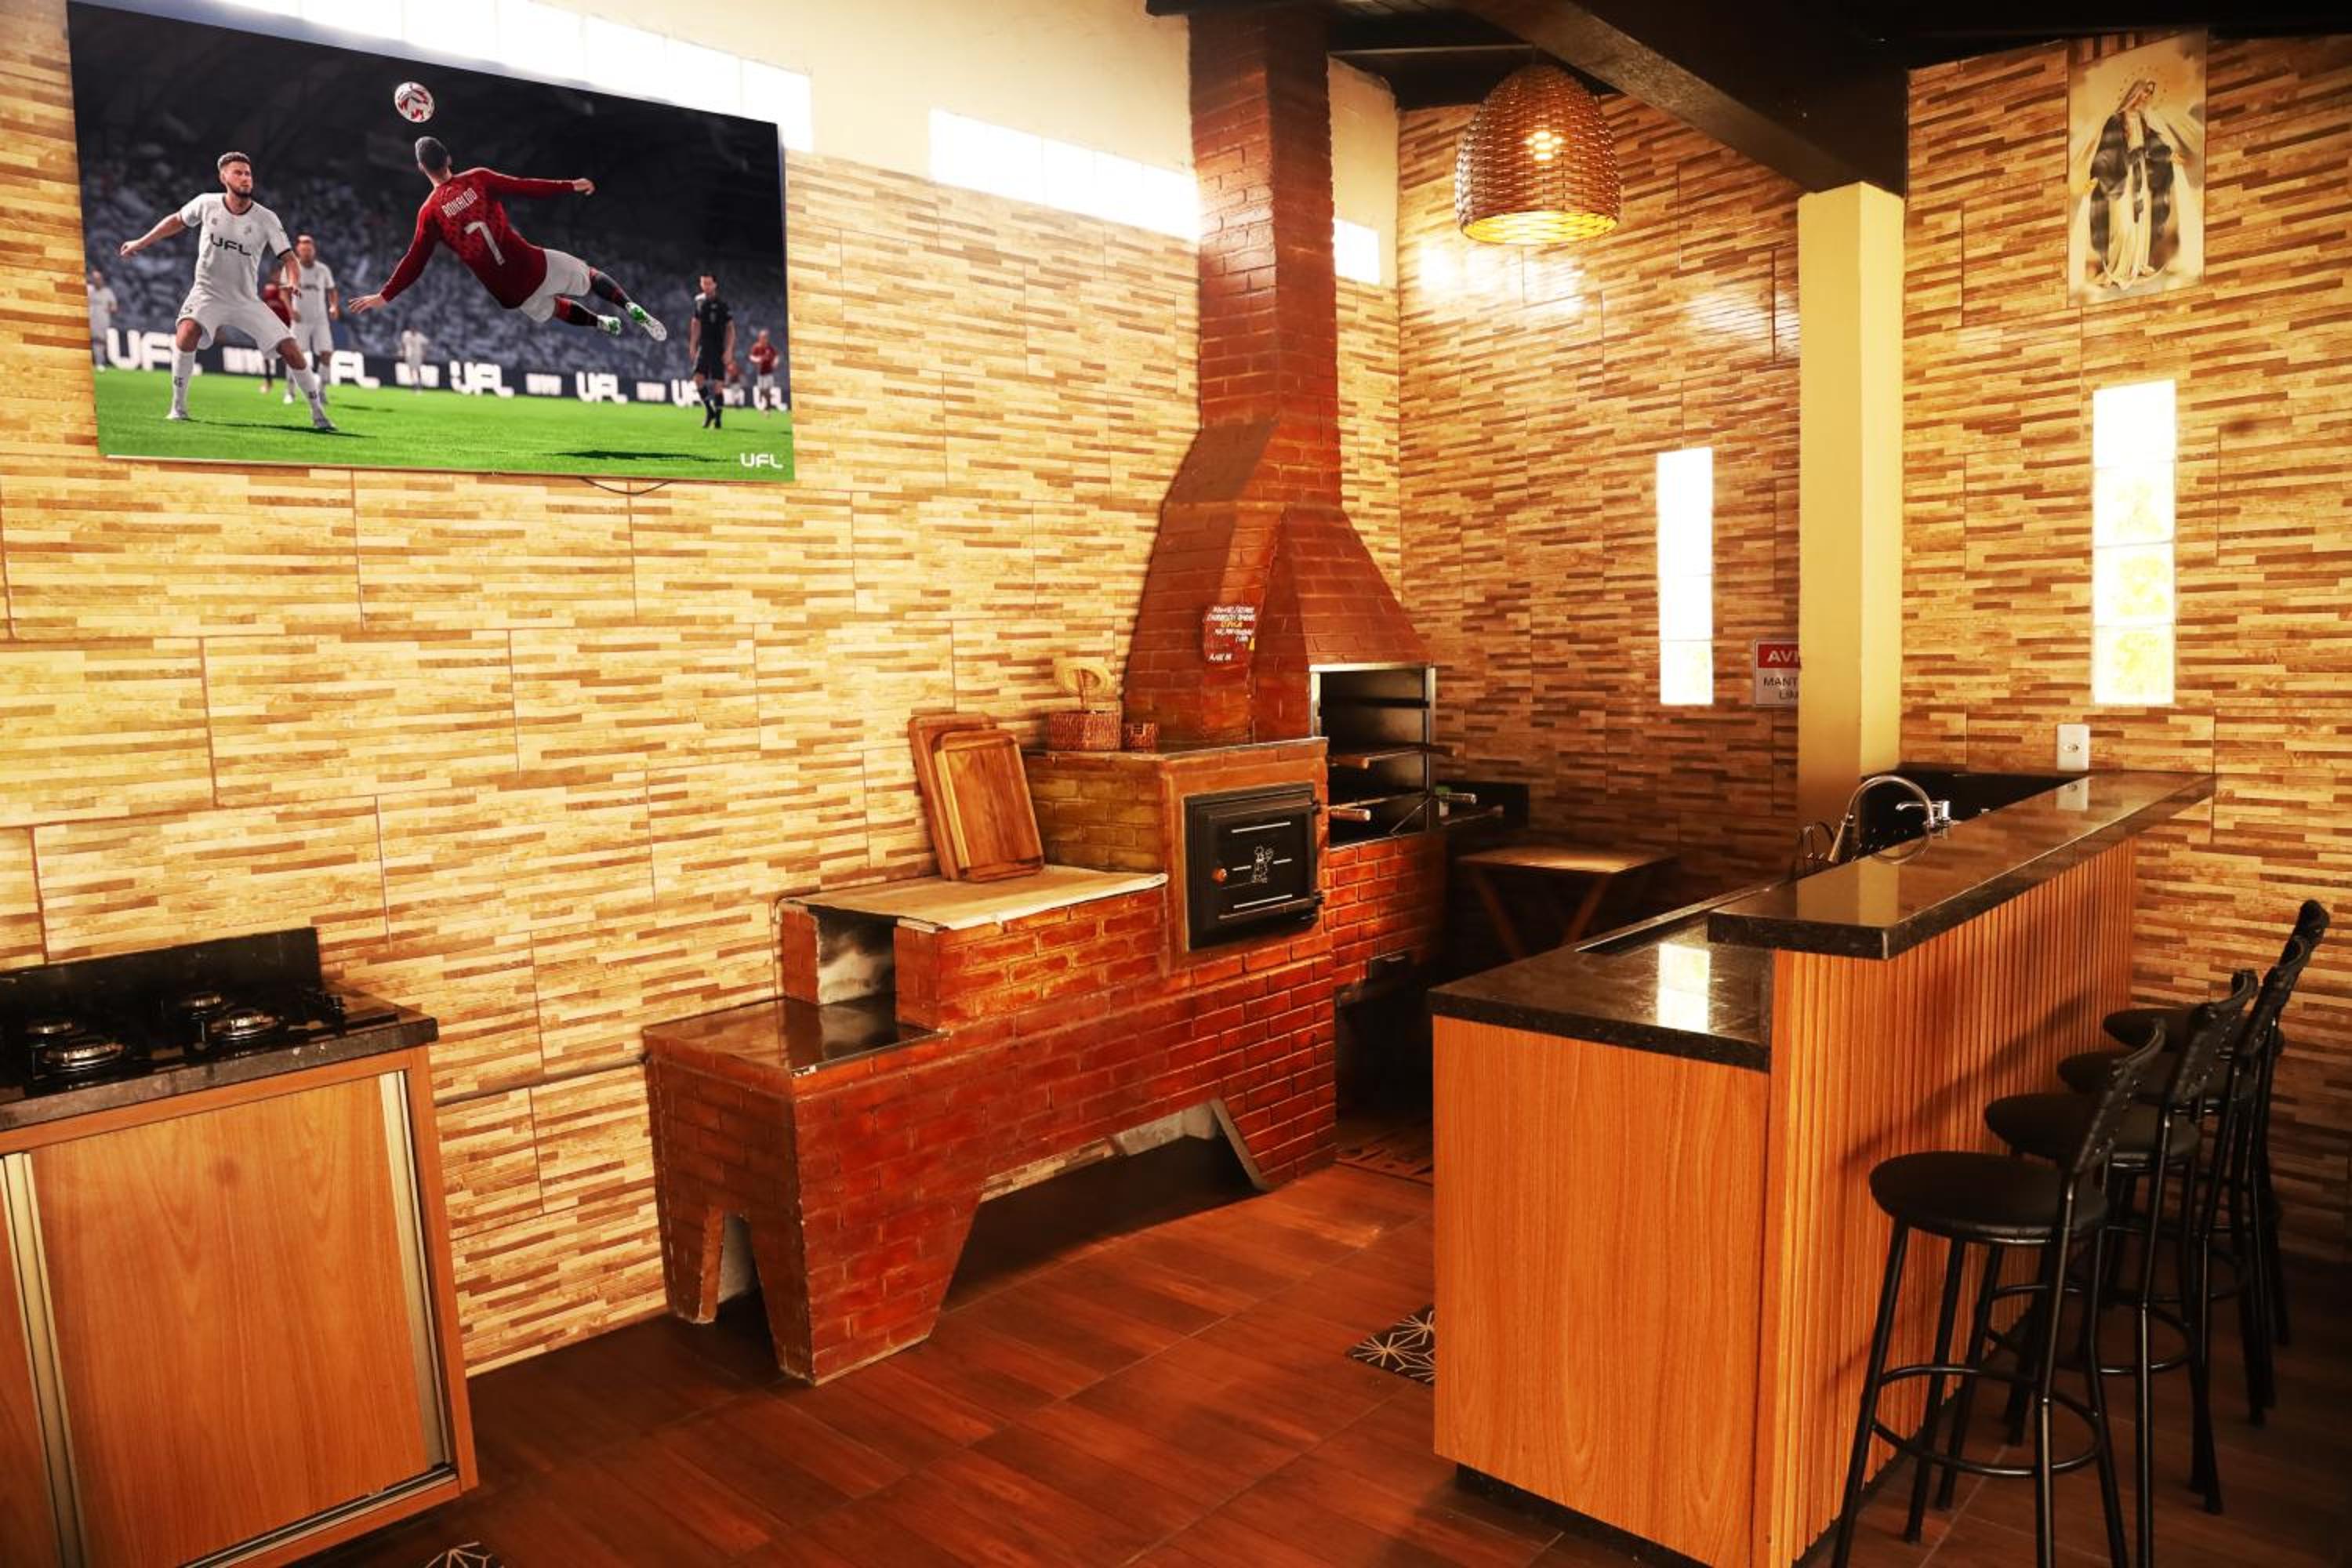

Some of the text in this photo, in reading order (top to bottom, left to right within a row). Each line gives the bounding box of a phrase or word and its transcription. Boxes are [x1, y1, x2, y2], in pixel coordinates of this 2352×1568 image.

[210, 233, 251, 256] UFL
[464, 221, 505, 266] 7
[107, 327, 202, 376] UF
[449, 360, 514, 397] UFL
[576, 372, 628, 404] UFL
[740, 453, 783, 468] UFL
